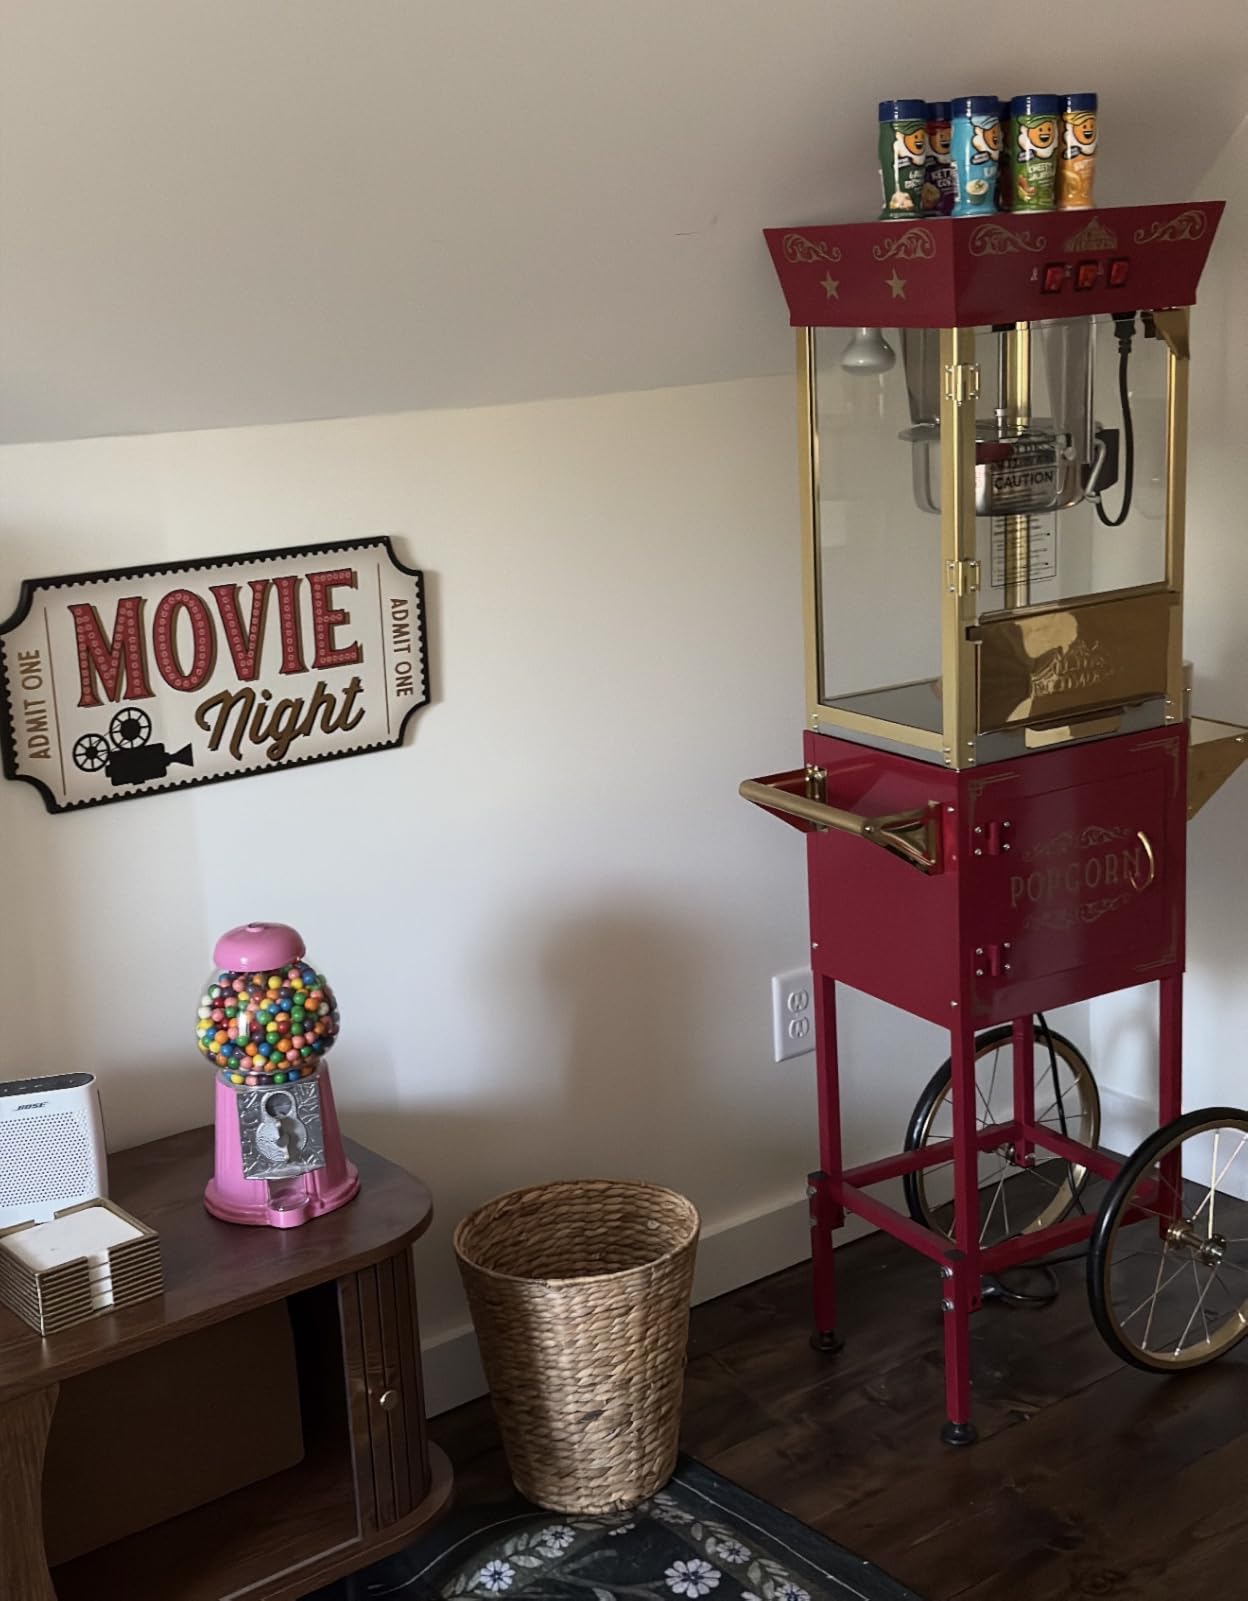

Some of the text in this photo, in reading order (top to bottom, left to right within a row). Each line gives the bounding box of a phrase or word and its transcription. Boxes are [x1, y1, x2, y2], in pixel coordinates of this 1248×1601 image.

[994, 471, 1054, 490] CAUTION
[68, 568, 364, 708] MOVIE
[390, 598, 414, 698] ADMIT ONE
[17, 649, 52, 760] ADMIT ONE
[195, 676, 366, 761] Night
[1010, 847, 1142, 908] POPCORN
[13, 1101, 49, 1112] BOSE
